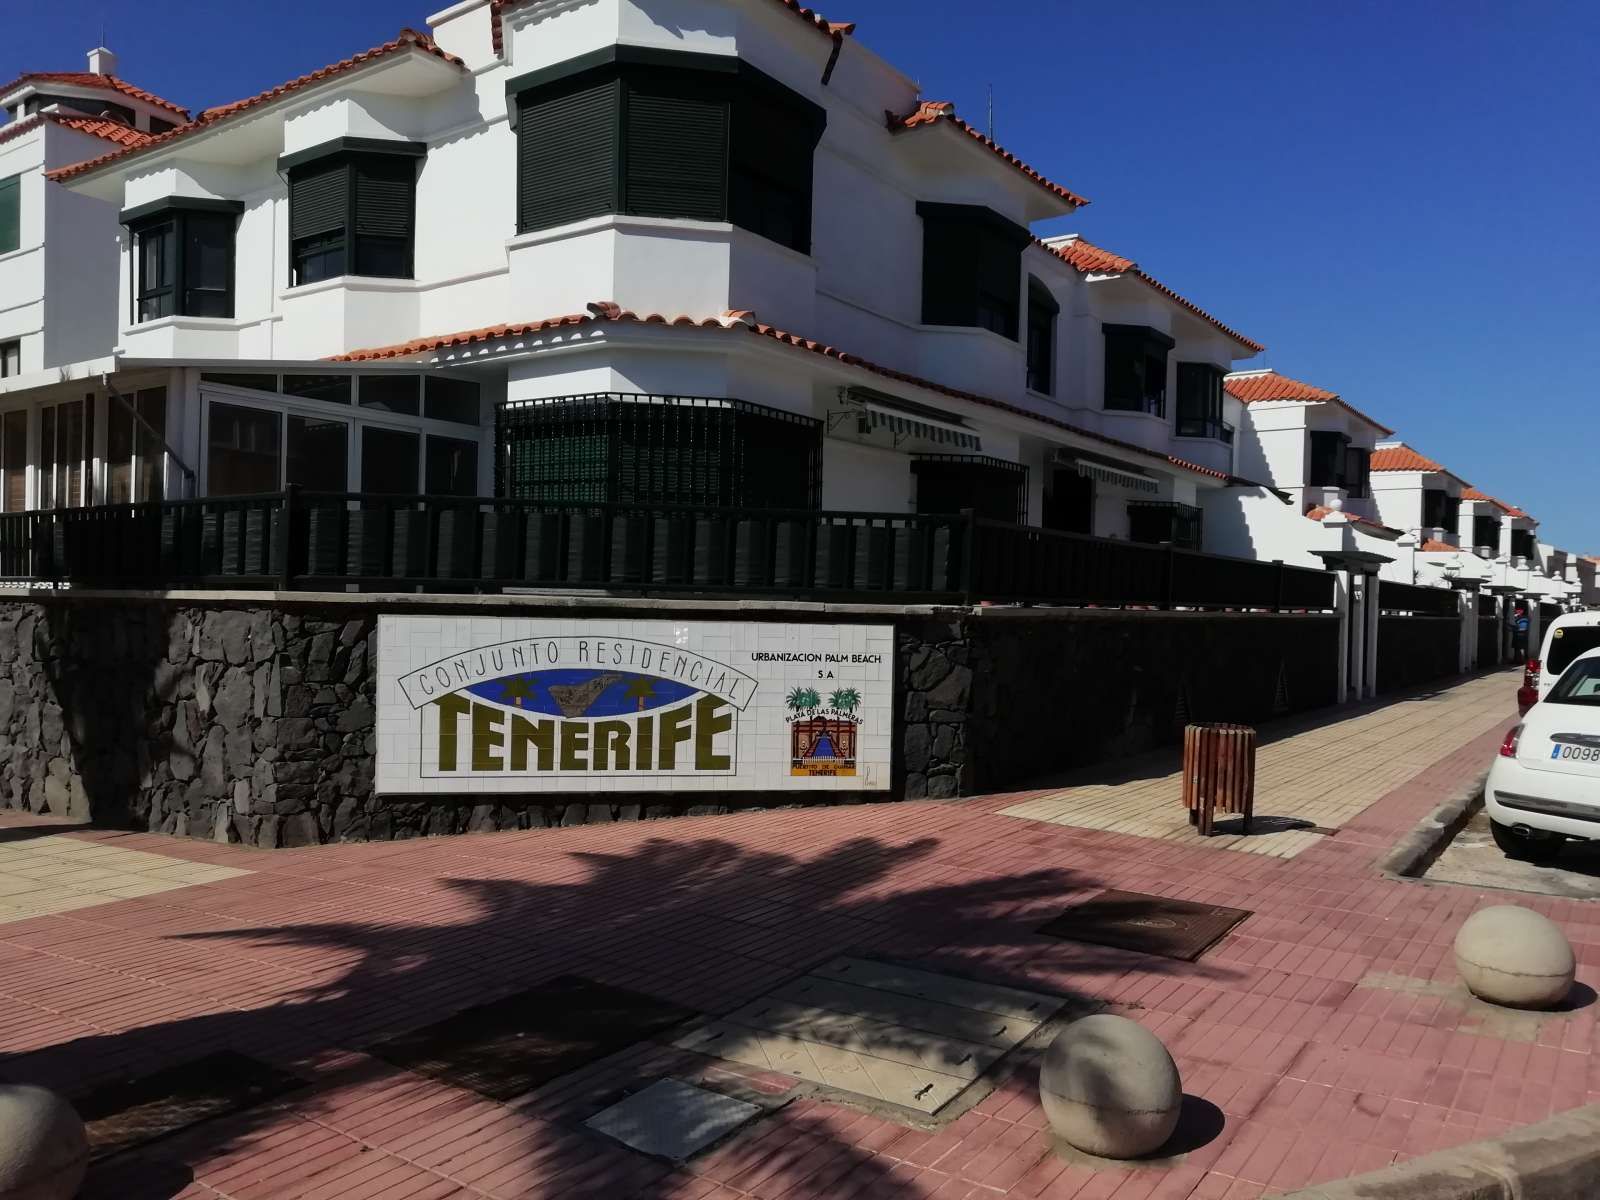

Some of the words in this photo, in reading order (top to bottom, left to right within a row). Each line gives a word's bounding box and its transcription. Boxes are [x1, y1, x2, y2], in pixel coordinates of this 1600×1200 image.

[751, 652, 822, 663] URBANIZACION
[825, 653, 849, 663] PALM
[851, 654, 882, 664] BEACH
[419, 641, 560, 696] CONJUNTO
[579, 640, 740, 700] RESIDENCIAL
[785, 711, 806, 723] PLAYA
[831, 708, 864, 725] PALMERAS
[432, 690, 733, 772] TENERIFE
[1562, 746, 1600, 762] 0098
[809, 769, 838, 777] TENERIFE
